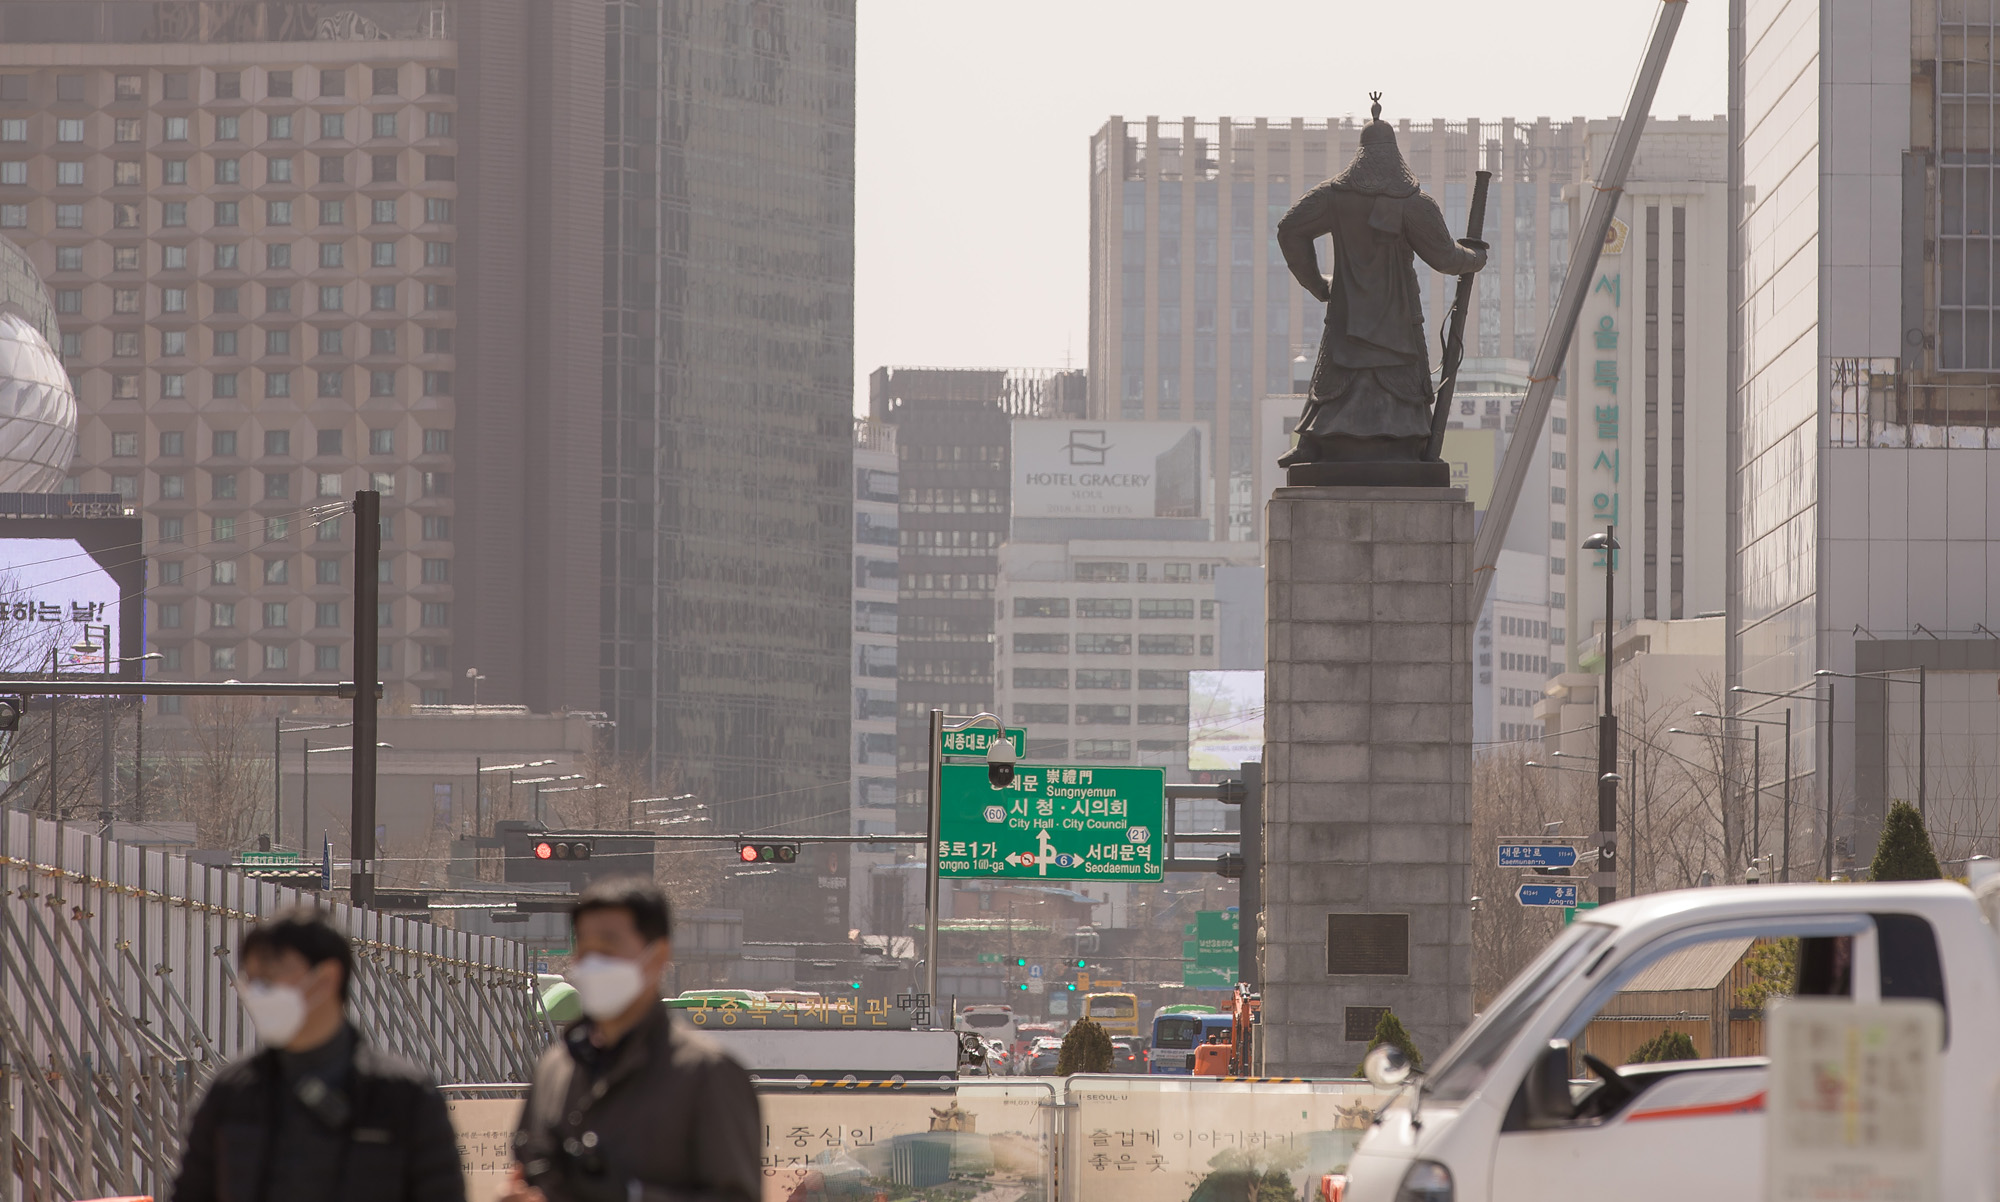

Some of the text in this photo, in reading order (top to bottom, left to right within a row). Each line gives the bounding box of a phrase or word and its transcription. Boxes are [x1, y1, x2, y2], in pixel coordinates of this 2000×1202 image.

[1026, 472, 1151, 487] HOTEL GRACERY
[72, 600, 104, 622] 날!
[944, 732, 1017, 751] 세종대로사리
[989, 774, 1038, 792] 례문
[1046, 769, 1092, 785] 崇禮門
[1046, 785, 1116, 799] Sungnyemun
[988, 809, 1001, 819] 60
[1071, 798, 1127, 817] 시의회
[1009, 818, 1127, 831] City Hall City Council
[1131, 829, 1145, 840] 21
[1086, 843, 1151, 862] 서대문역
[1501, 847, 1542, 858] 새문안로
[939, 860, 969, 872] ongno
[1085, 861, 1160, 874] Seodaemun Stn
[1555, 887, 1574, 898] 종로
[686, 995, 893, 1026] 궁중복식체험관
[785, 1124, 875, 1148] 중심인
[1088, 1128, 1294, 1149] 즐겁게 이야기하기
[494, 1142, 516, 1157] 넓
[760, 1154, 816, 1177] 광장
[1087, 1153, 1169, 1172] 좋은 곳
